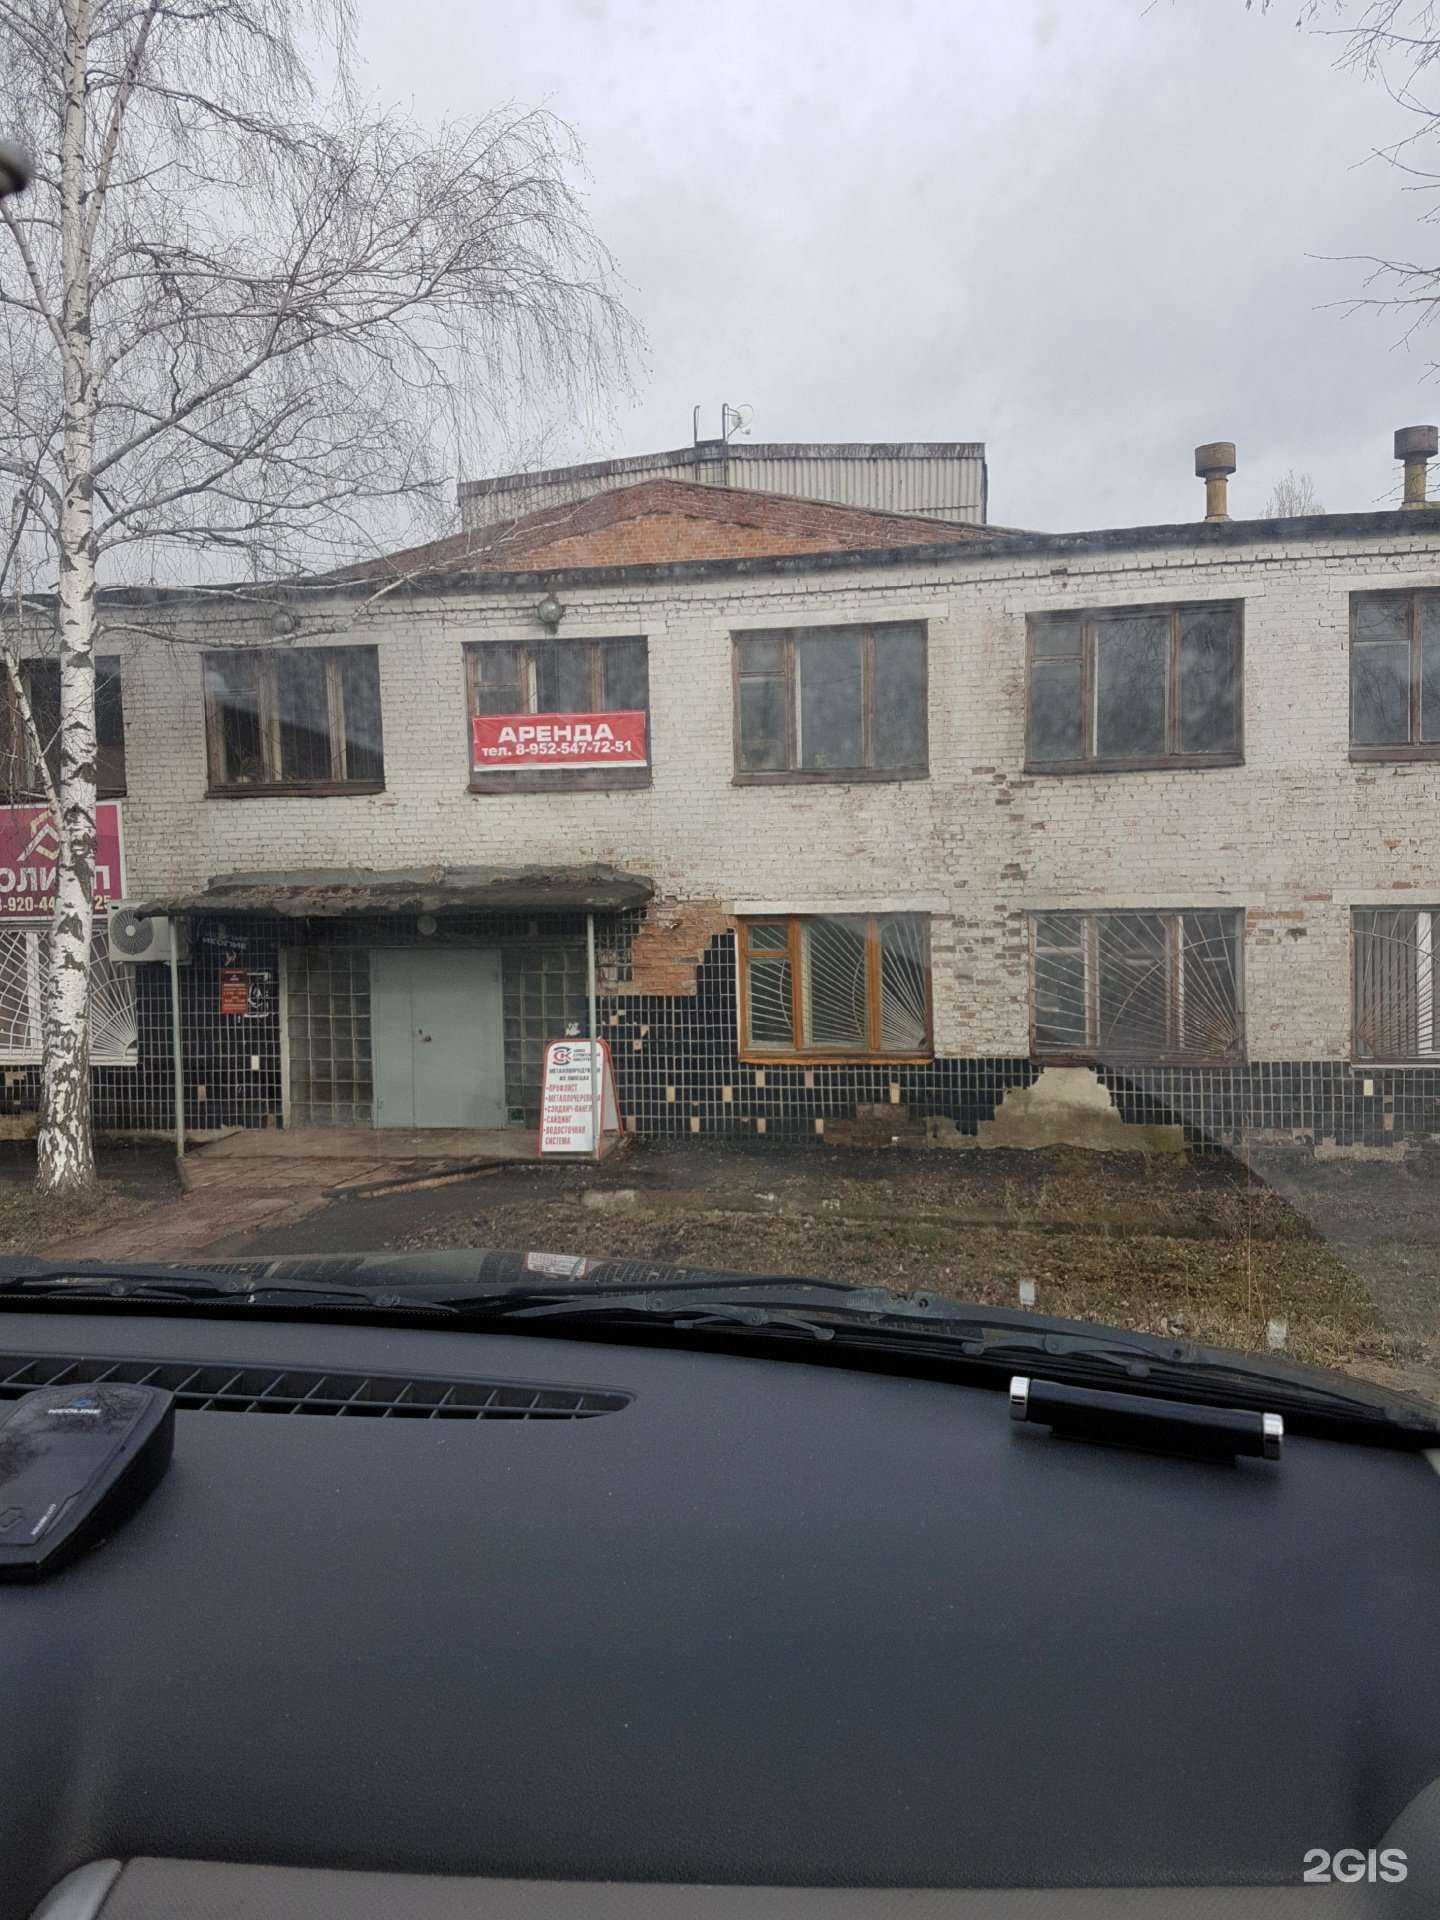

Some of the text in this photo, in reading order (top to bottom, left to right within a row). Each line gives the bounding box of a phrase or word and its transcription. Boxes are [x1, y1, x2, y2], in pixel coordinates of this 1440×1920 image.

[498, 723, 615, 744] АРЕНДА
[481, 740, 632, 757] тел. 8-952-547-72-51
[0, 866, 111, 893] ОЛИП
[547, 1105, 594, 1113] СЭНДВИЧ-ПАНЕЛ
[545, 1136, 571, 1145] СИСТЕМА
